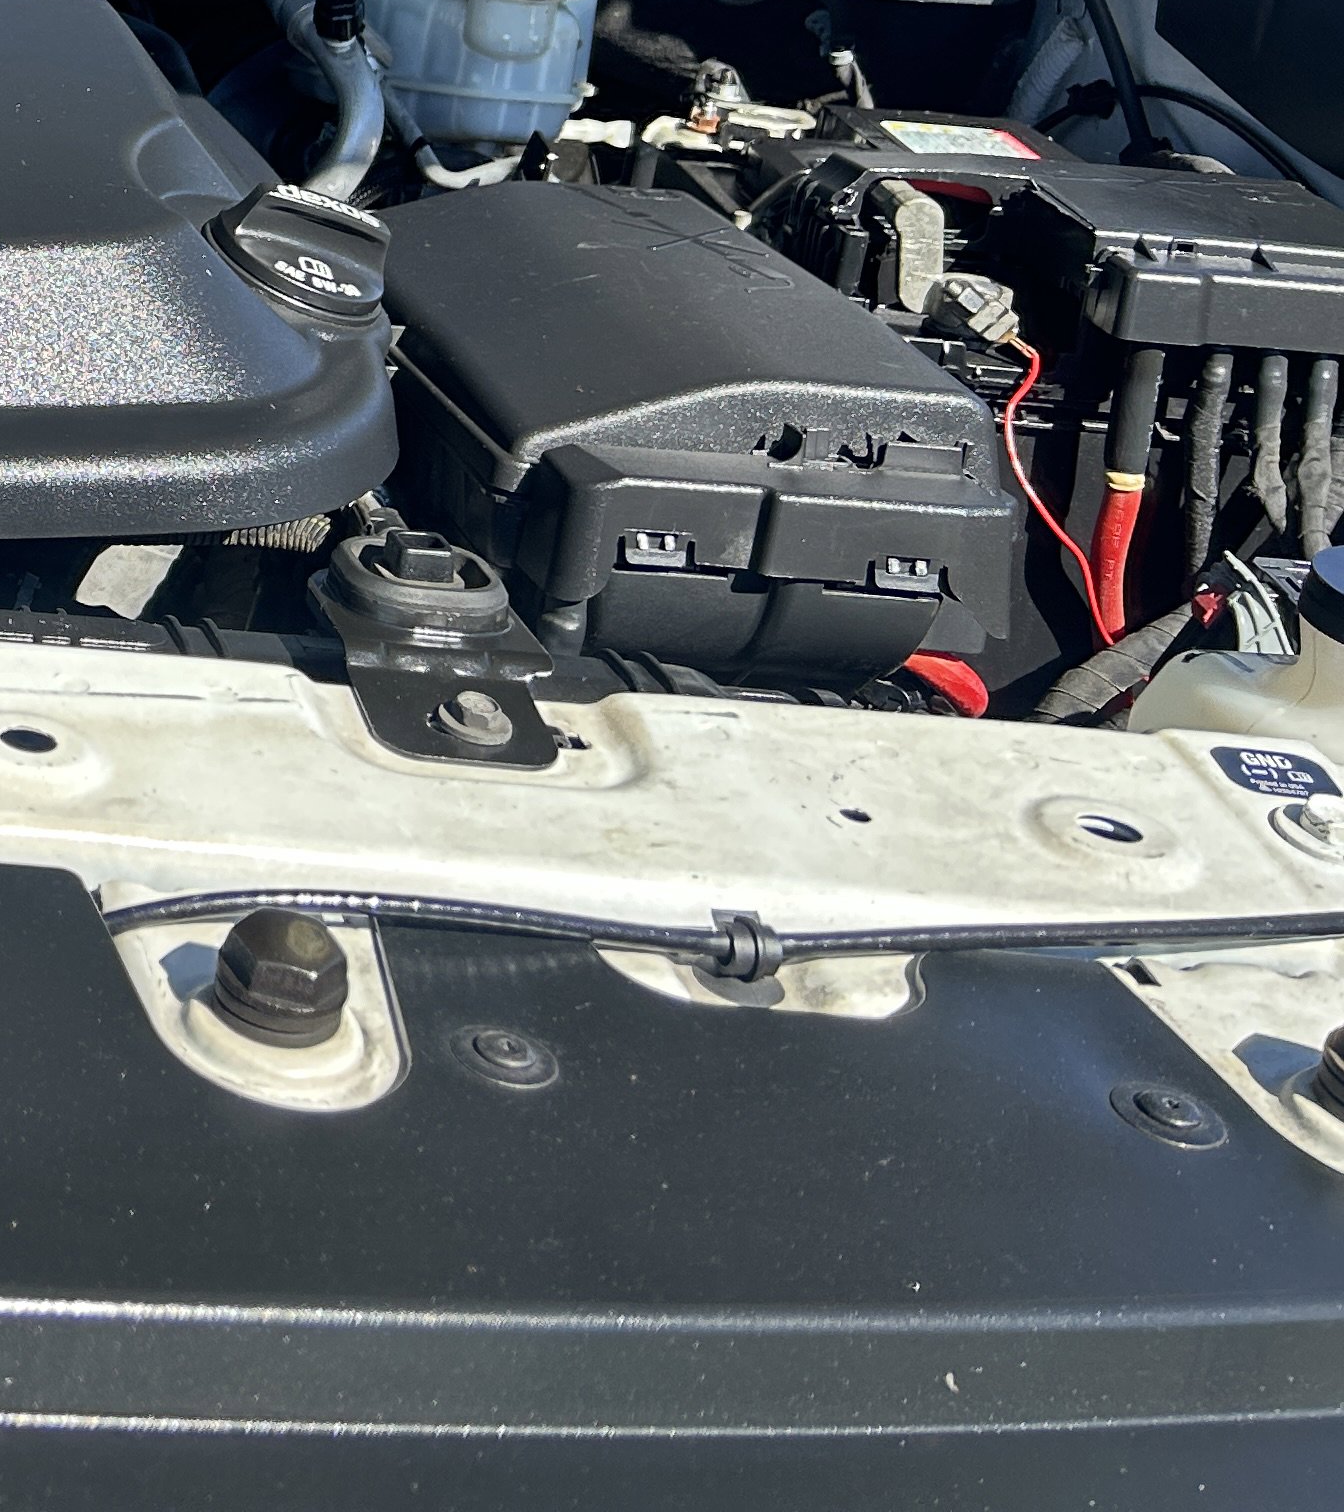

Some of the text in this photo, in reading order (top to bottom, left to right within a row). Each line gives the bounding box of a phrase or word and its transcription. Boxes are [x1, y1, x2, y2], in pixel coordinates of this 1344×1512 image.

[276, 184, 381, 228] dexos
[274, 260, 306, 282] SAE
[1240, 752, 1293, 770] GND
